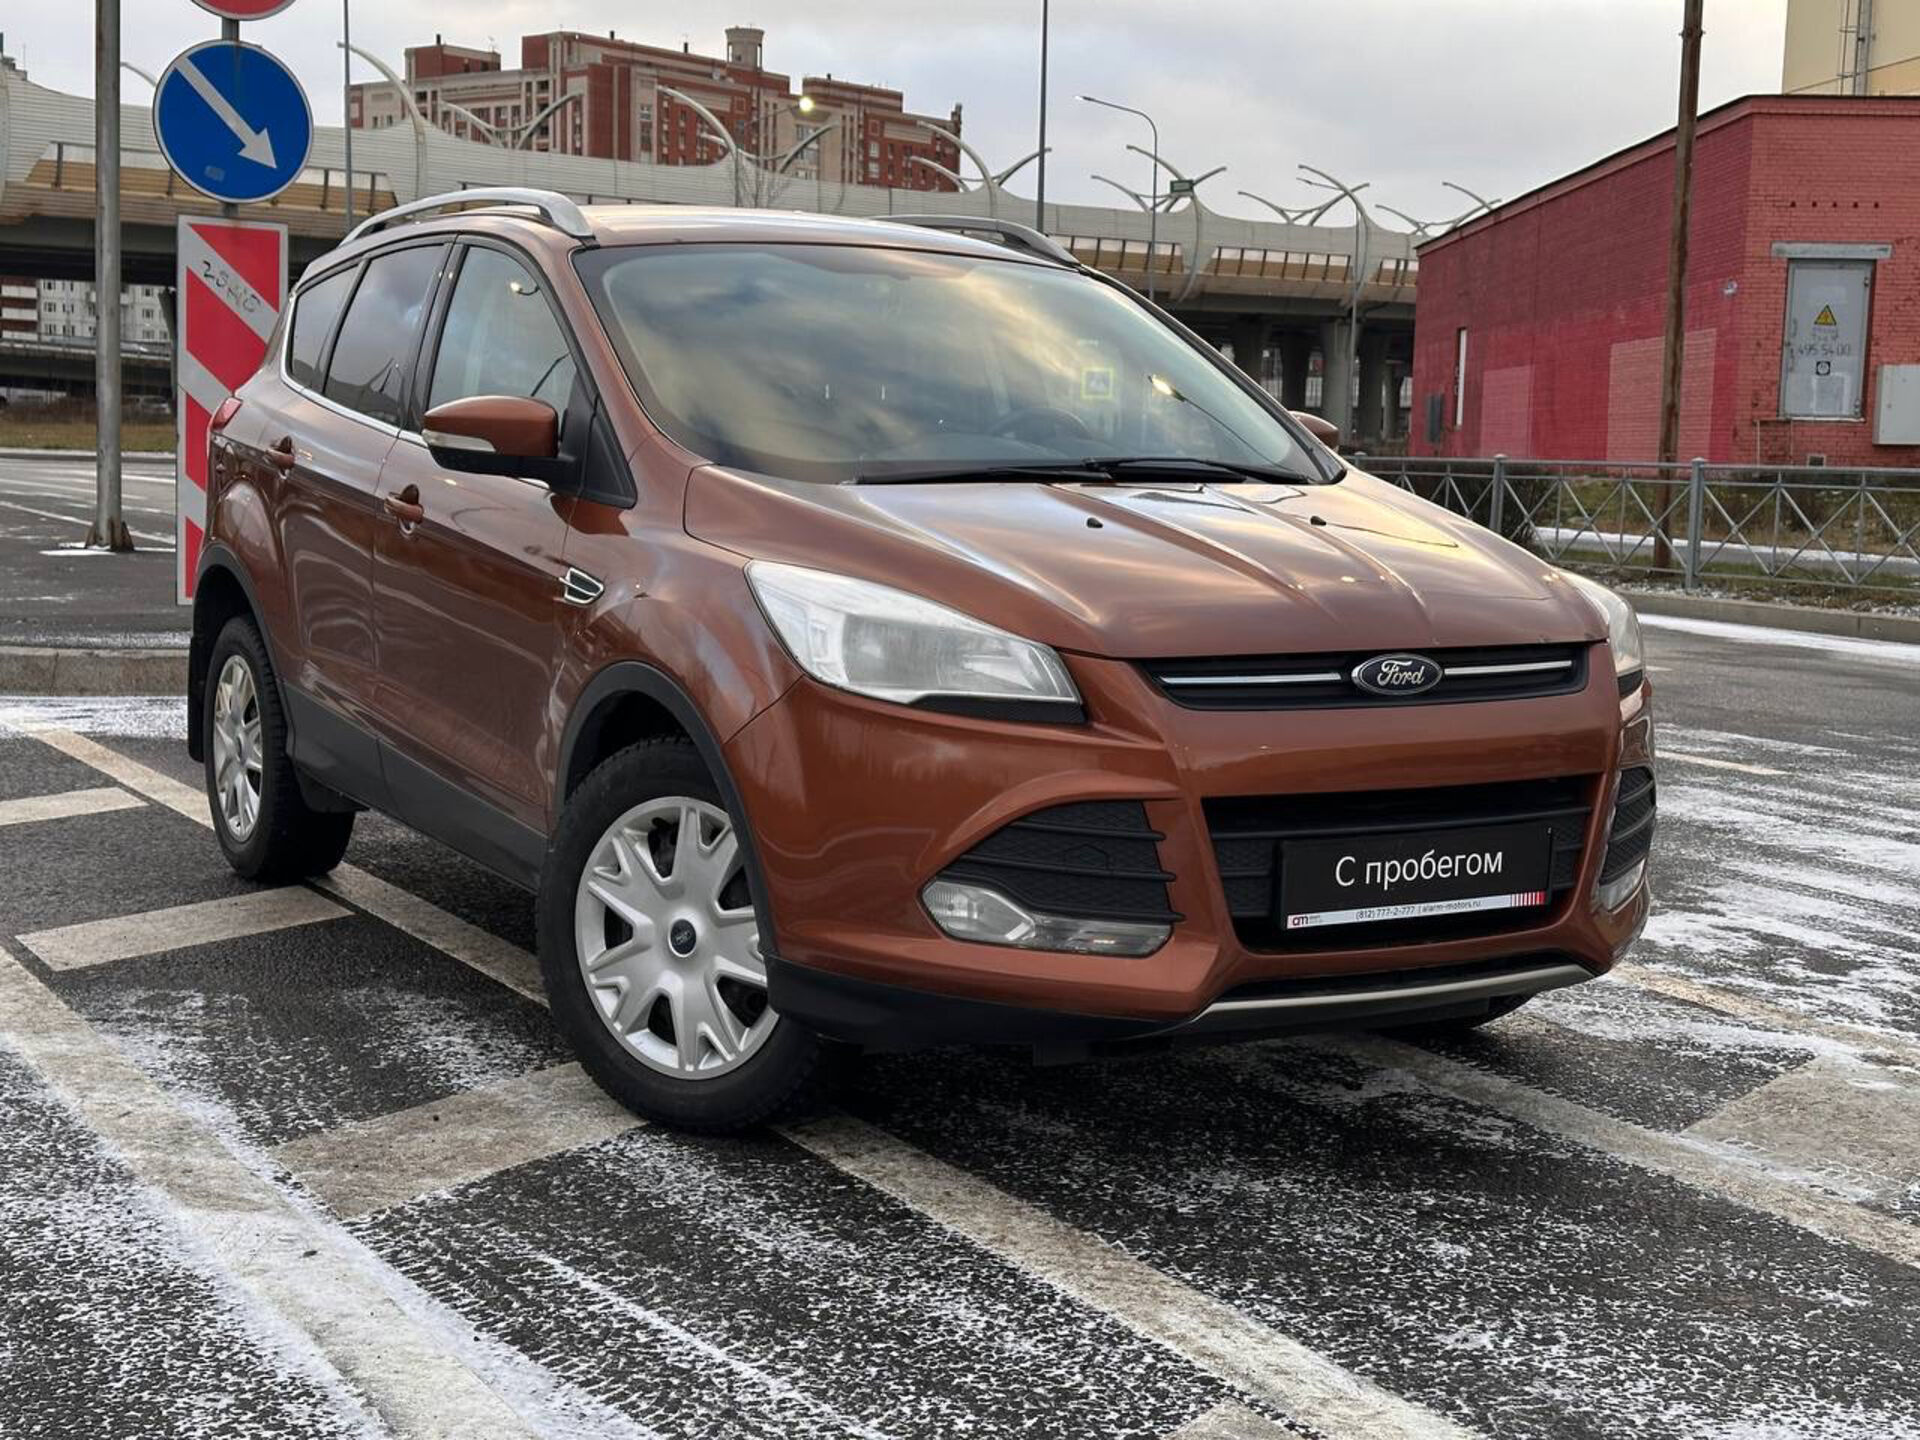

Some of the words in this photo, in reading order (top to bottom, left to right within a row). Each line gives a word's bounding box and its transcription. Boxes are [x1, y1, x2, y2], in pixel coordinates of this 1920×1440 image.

[1377, 660, 1425, 686] Ford
[1335, 856, 1356, 887] С
[1365, 849, 1503, 891] пробегом
[1355, 910, 1375, 920] (812)
[1376, 906, 1415, 918] 777-2-777
[1422, 901, 1482, 912] alarm-motors.ru
